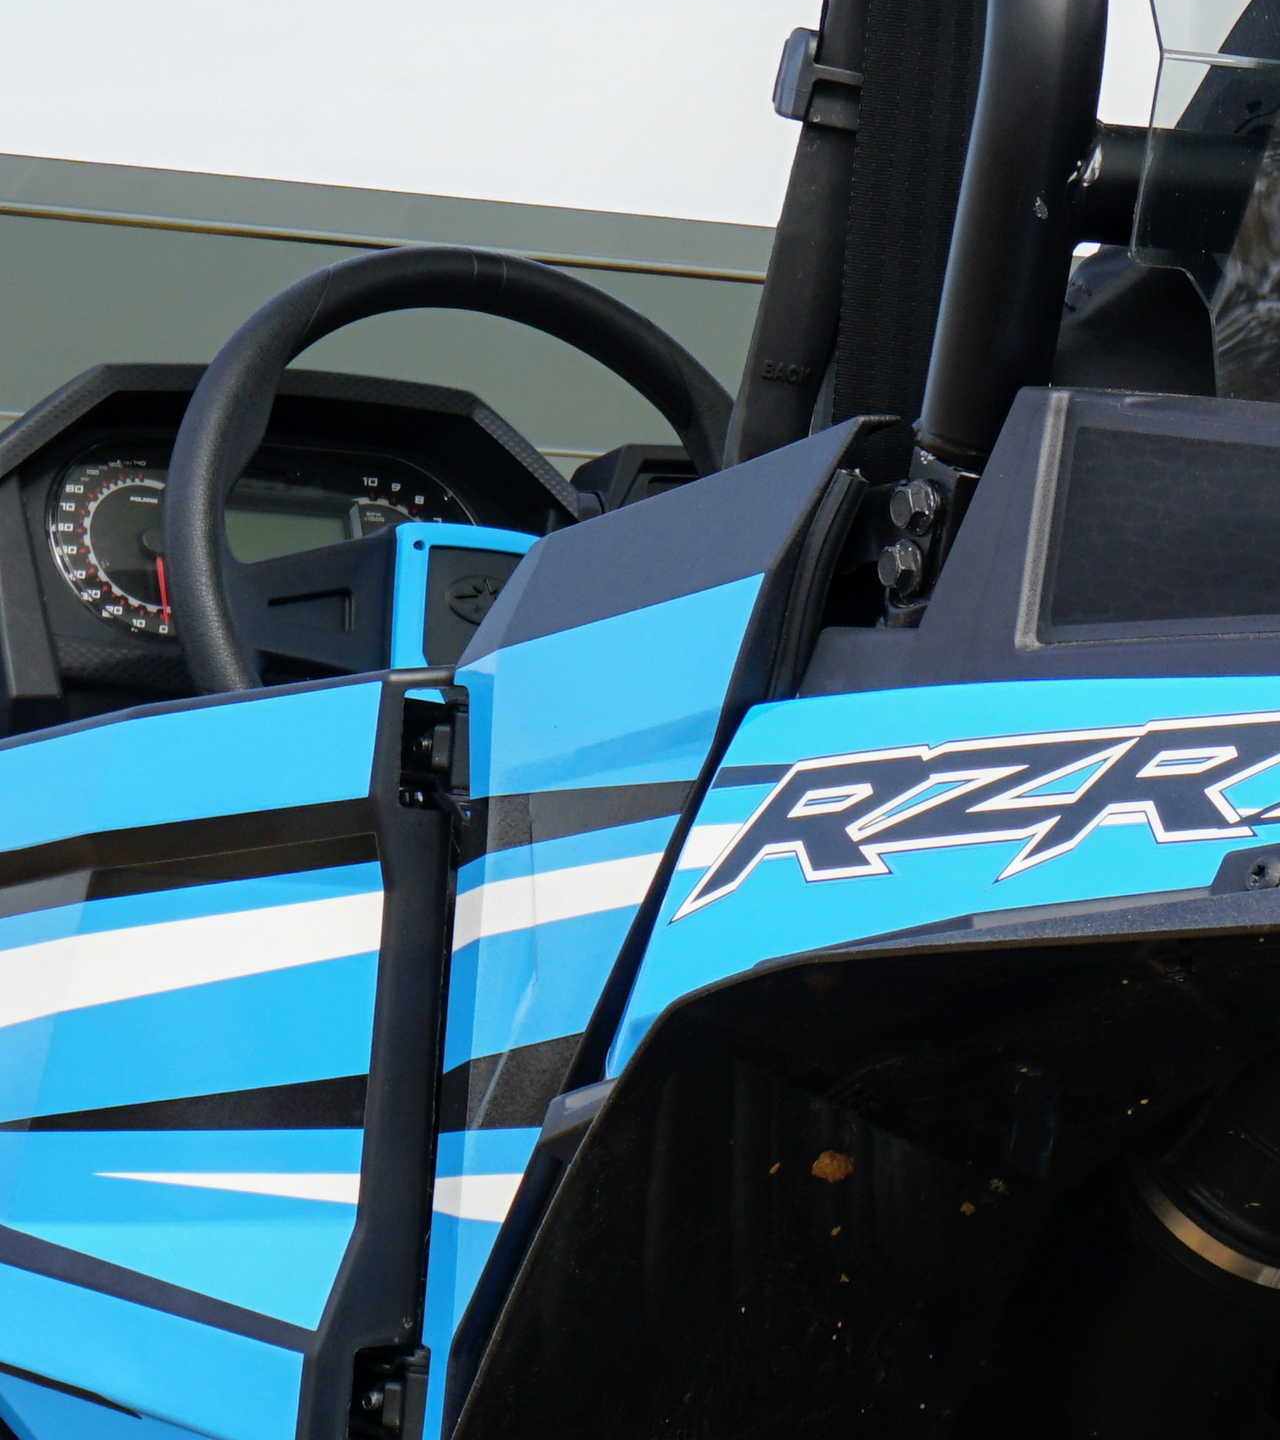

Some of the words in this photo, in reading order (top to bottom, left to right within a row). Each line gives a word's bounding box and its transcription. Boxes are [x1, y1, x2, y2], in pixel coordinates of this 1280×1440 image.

[363, 477, 378, 486] 10
[65, 483, 84, 494] 80
[392, 483, 401, 491] 9
[415, 496, 424, 504] 8
[60, 502, 76, 512] 70
[131, 618, 146, 628] 10
[159, 625, 168, 633] 0
